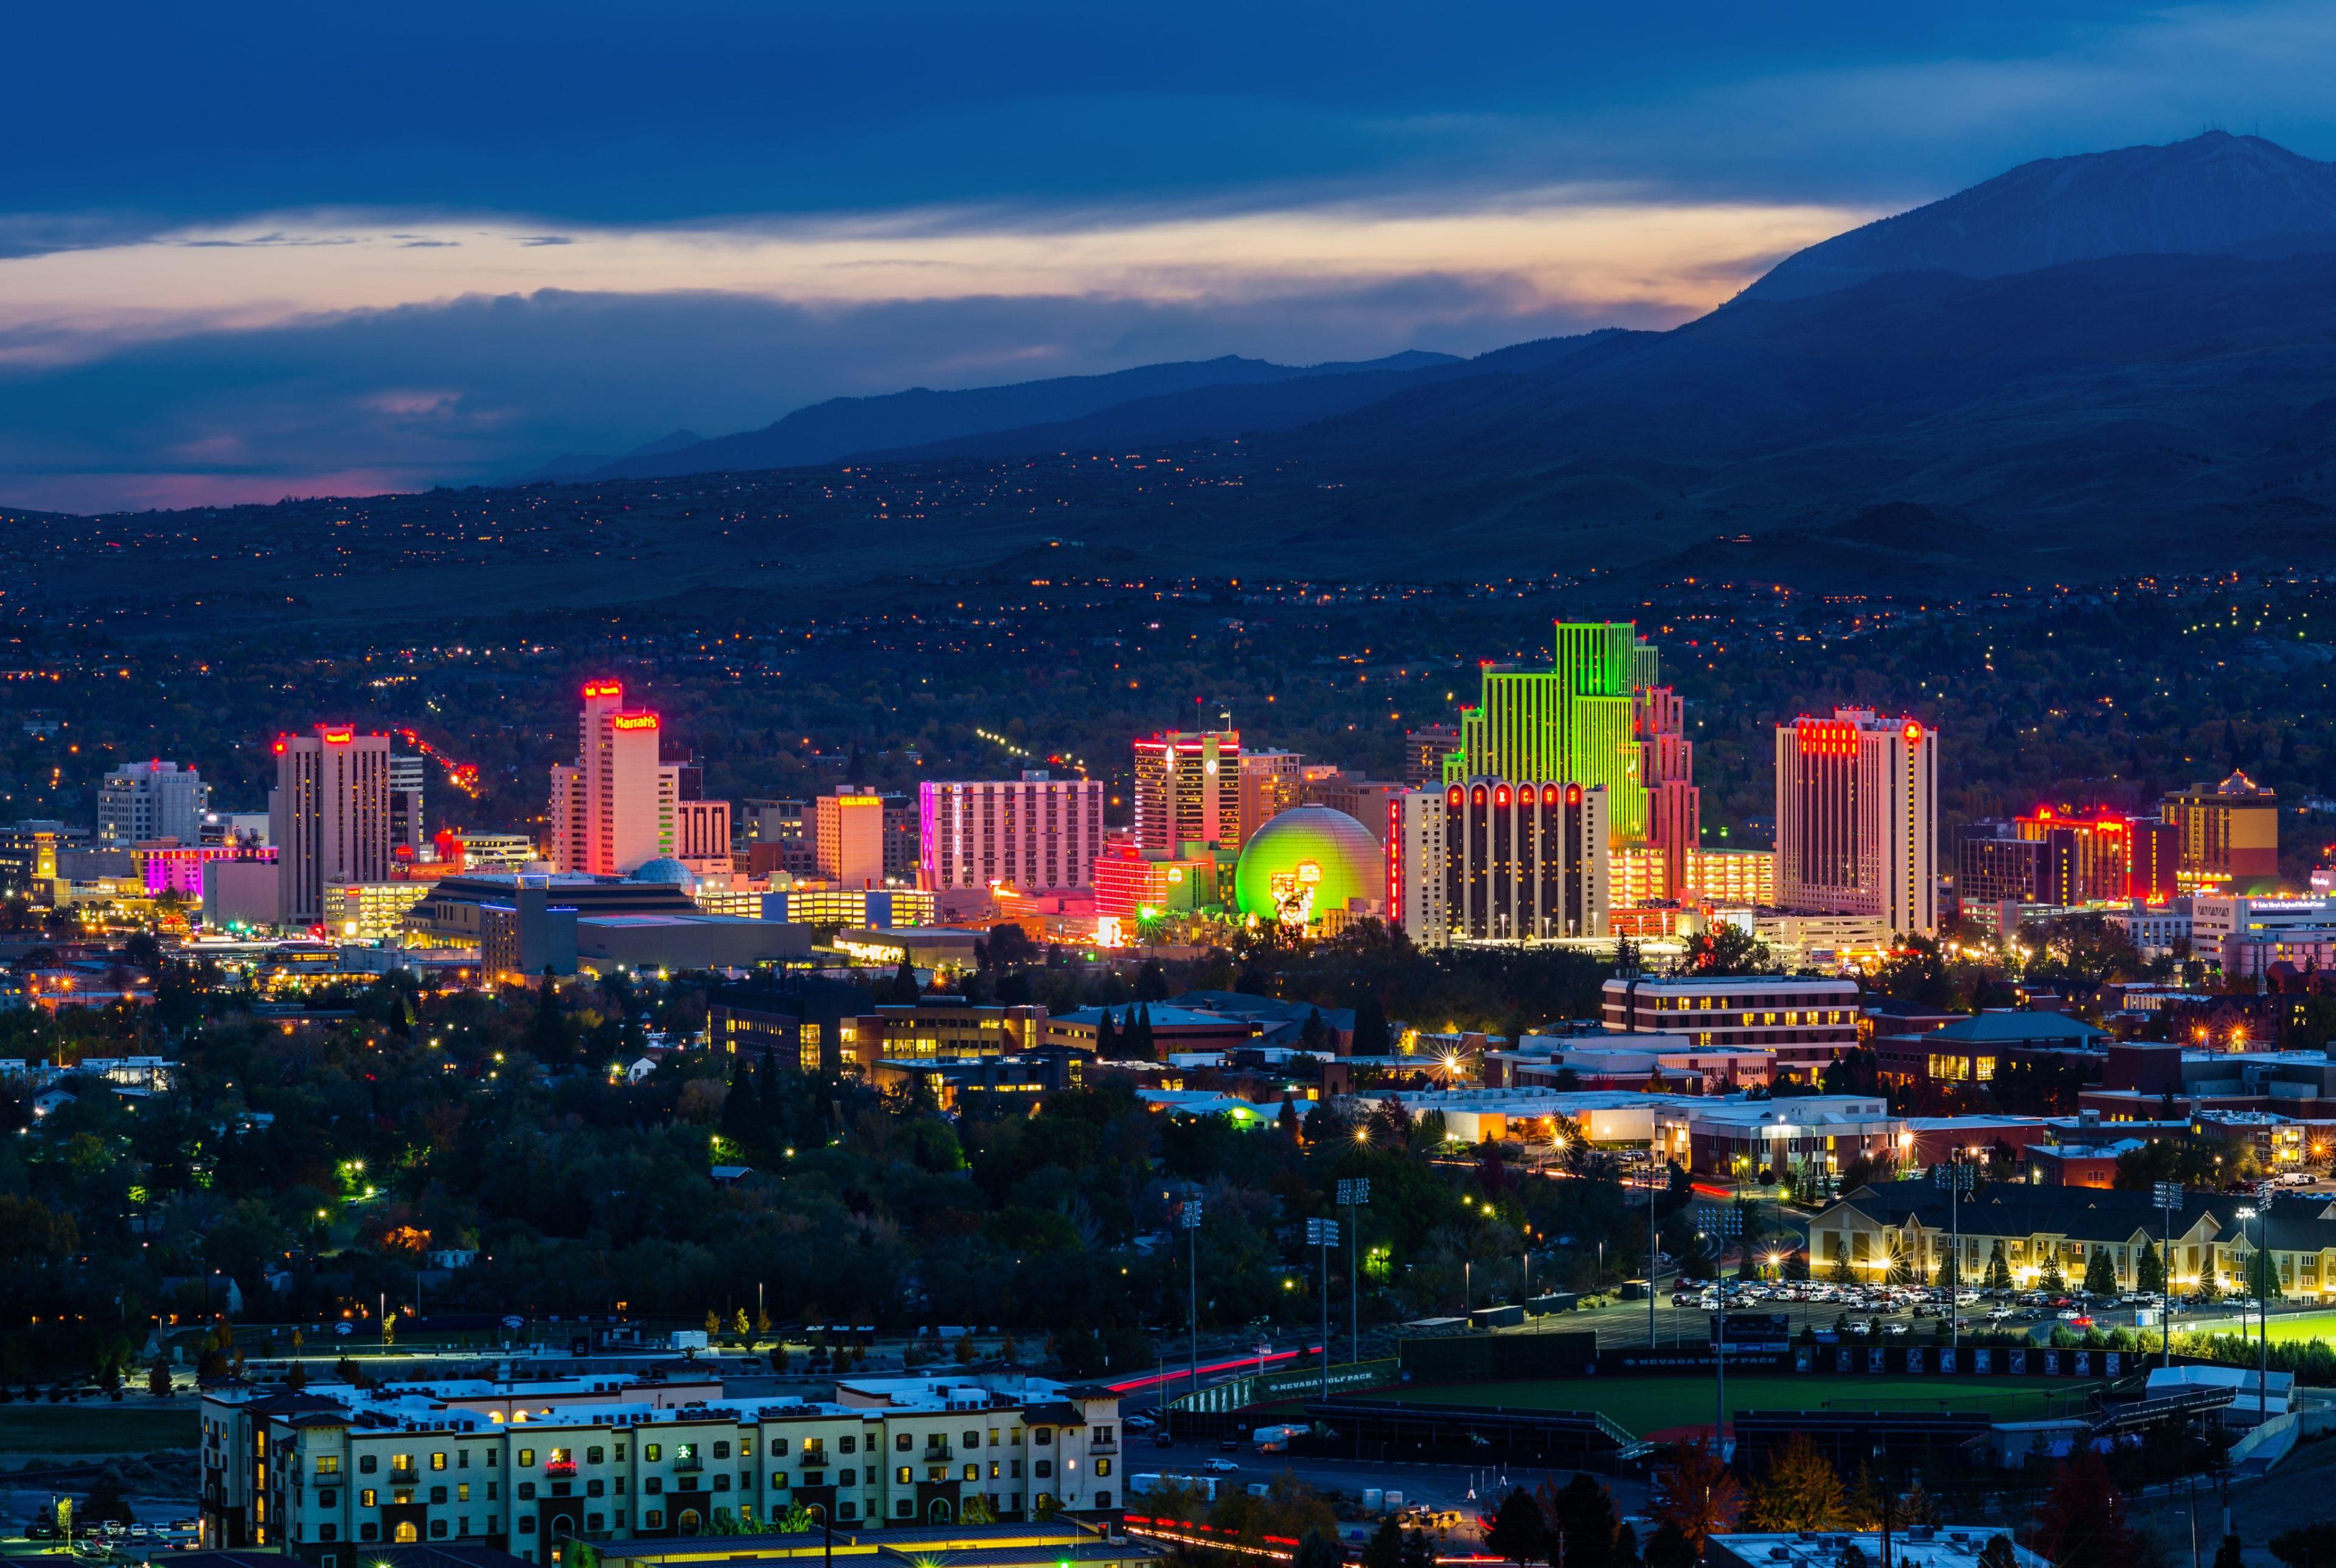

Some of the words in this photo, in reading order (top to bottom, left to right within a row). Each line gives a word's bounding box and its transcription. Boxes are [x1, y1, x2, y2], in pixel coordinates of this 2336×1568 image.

[615, 715, 657, 729] Harrah's
[1451, 791, 1576, 803] CIRCUS
[1279, 1379, 1318, 1390] NEVADA
[1347, 1372, 1372, 1381] PACK
